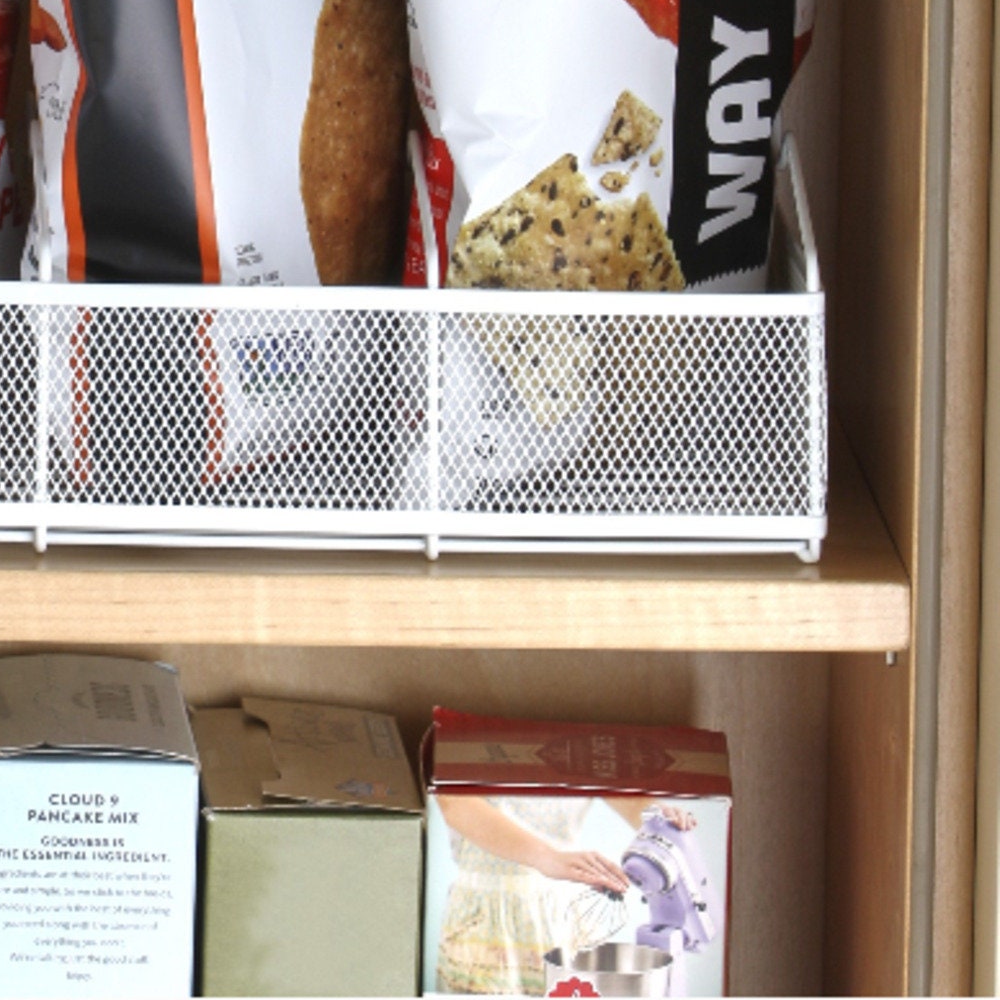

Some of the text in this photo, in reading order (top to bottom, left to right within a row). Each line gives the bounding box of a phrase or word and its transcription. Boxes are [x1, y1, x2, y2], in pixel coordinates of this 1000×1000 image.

[697, 14, 772, 244] WAY
[48, 793, 120, 807] CLOUD 9
[27, 809, 140, 824] PANCAKE MIX
[22, 849, 87, 861] ESSENTIAL
